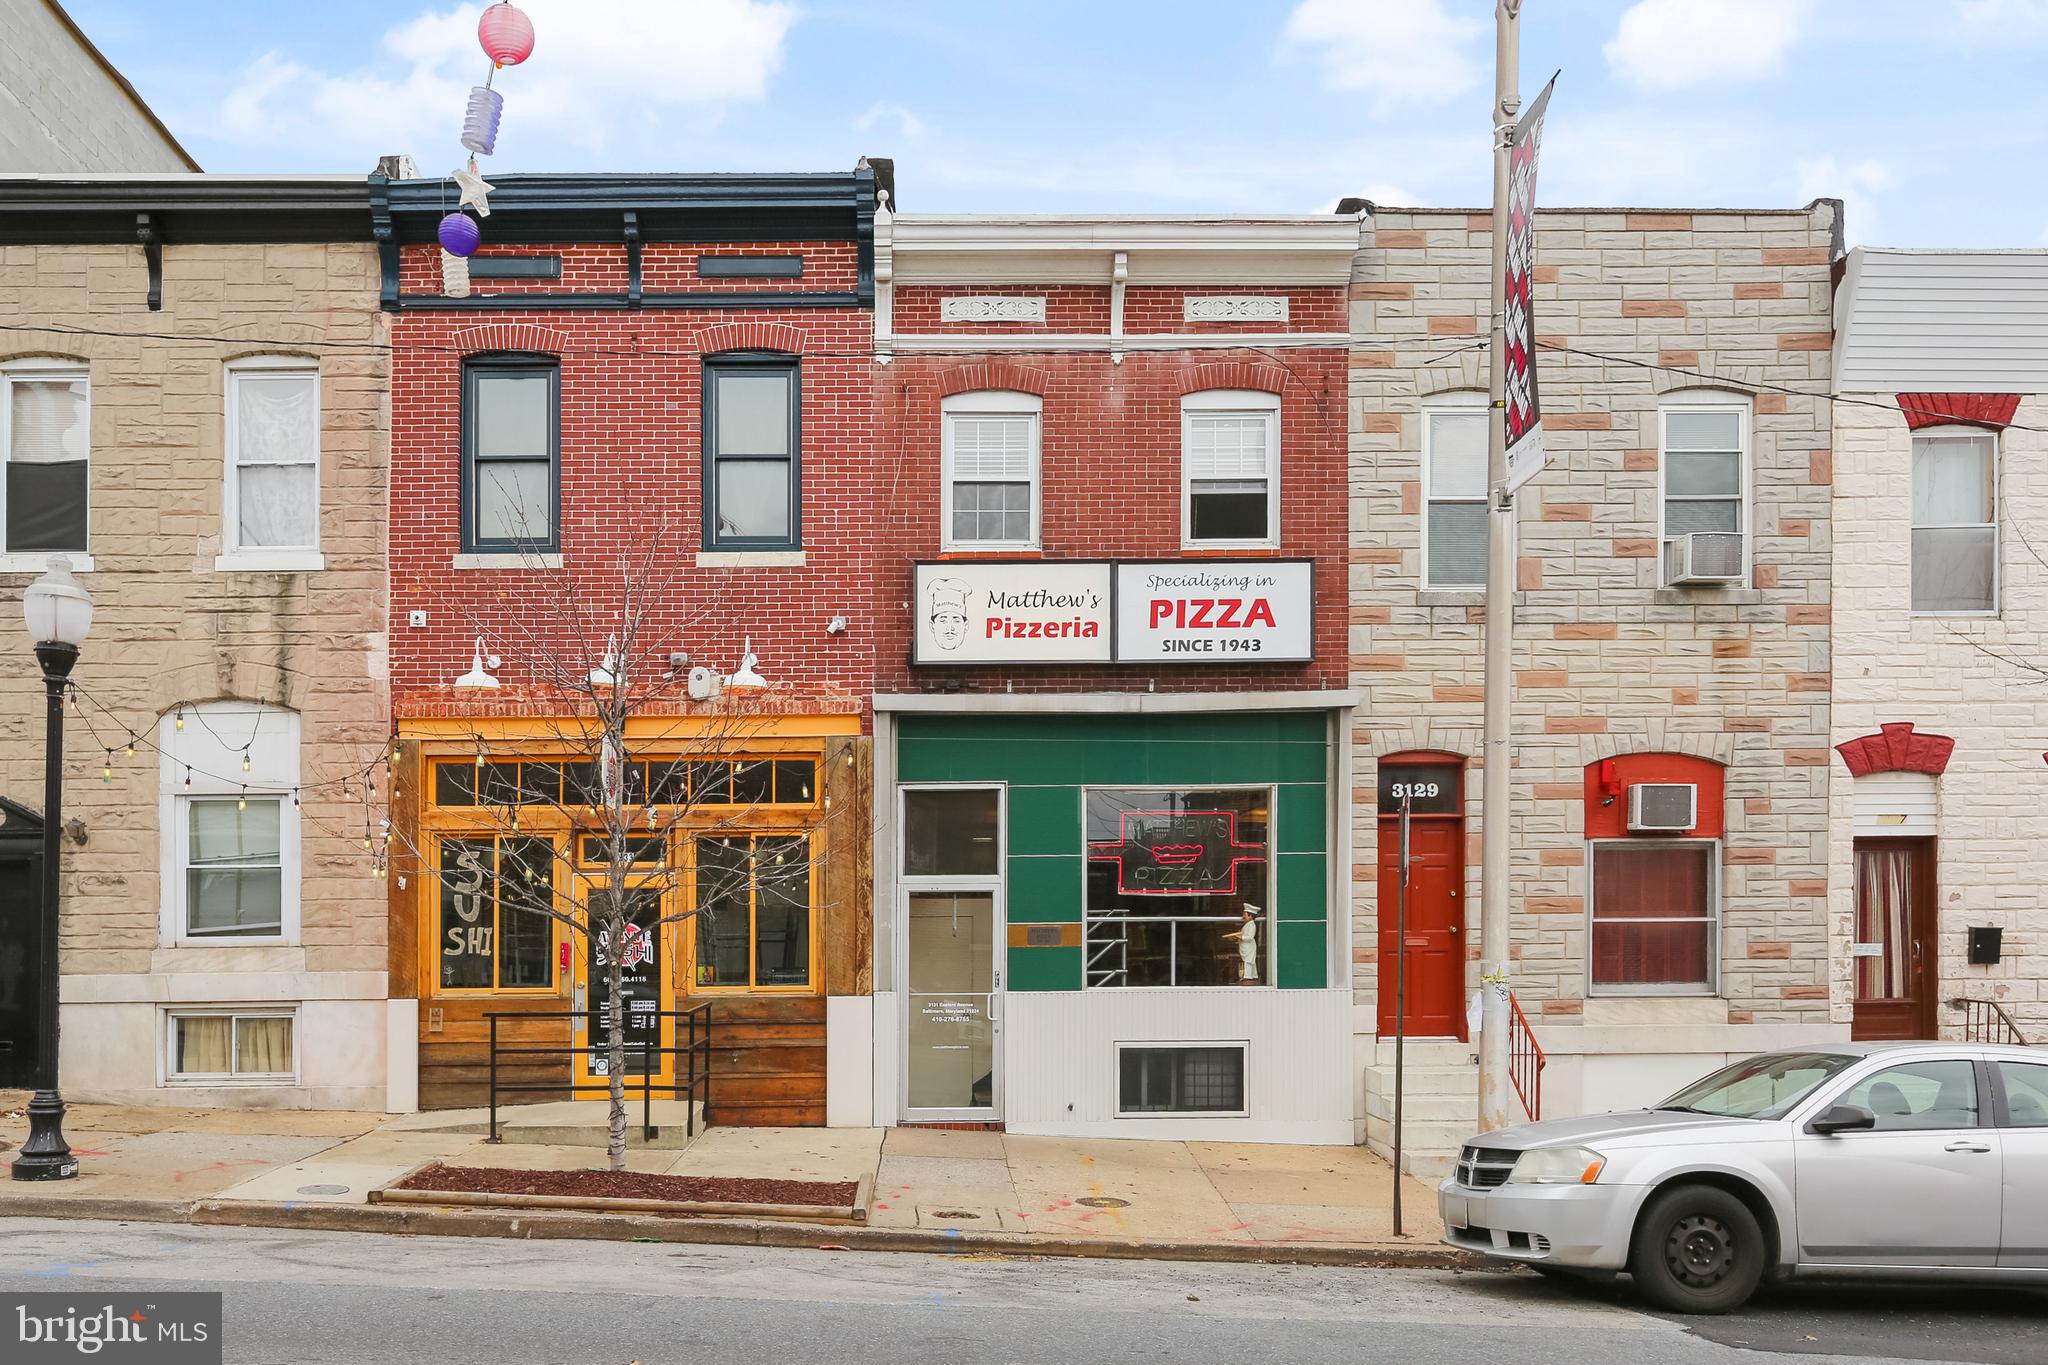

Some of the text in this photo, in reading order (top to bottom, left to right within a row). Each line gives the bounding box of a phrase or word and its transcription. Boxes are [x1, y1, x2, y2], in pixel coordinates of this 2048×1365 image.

[1146, 573, 1277, 591] Specializing in
[987, 588, 1103, 610] Matthew's
[1149, 598, 1278, 629] PIZZA
[985, 616, 1100, 639] Pizzeria
[1162, 638, 1262, 652] SINCE 1943
[1391, 783, 1439, 798] 3129
[1135, 866, 1215, 888] PIZZA
